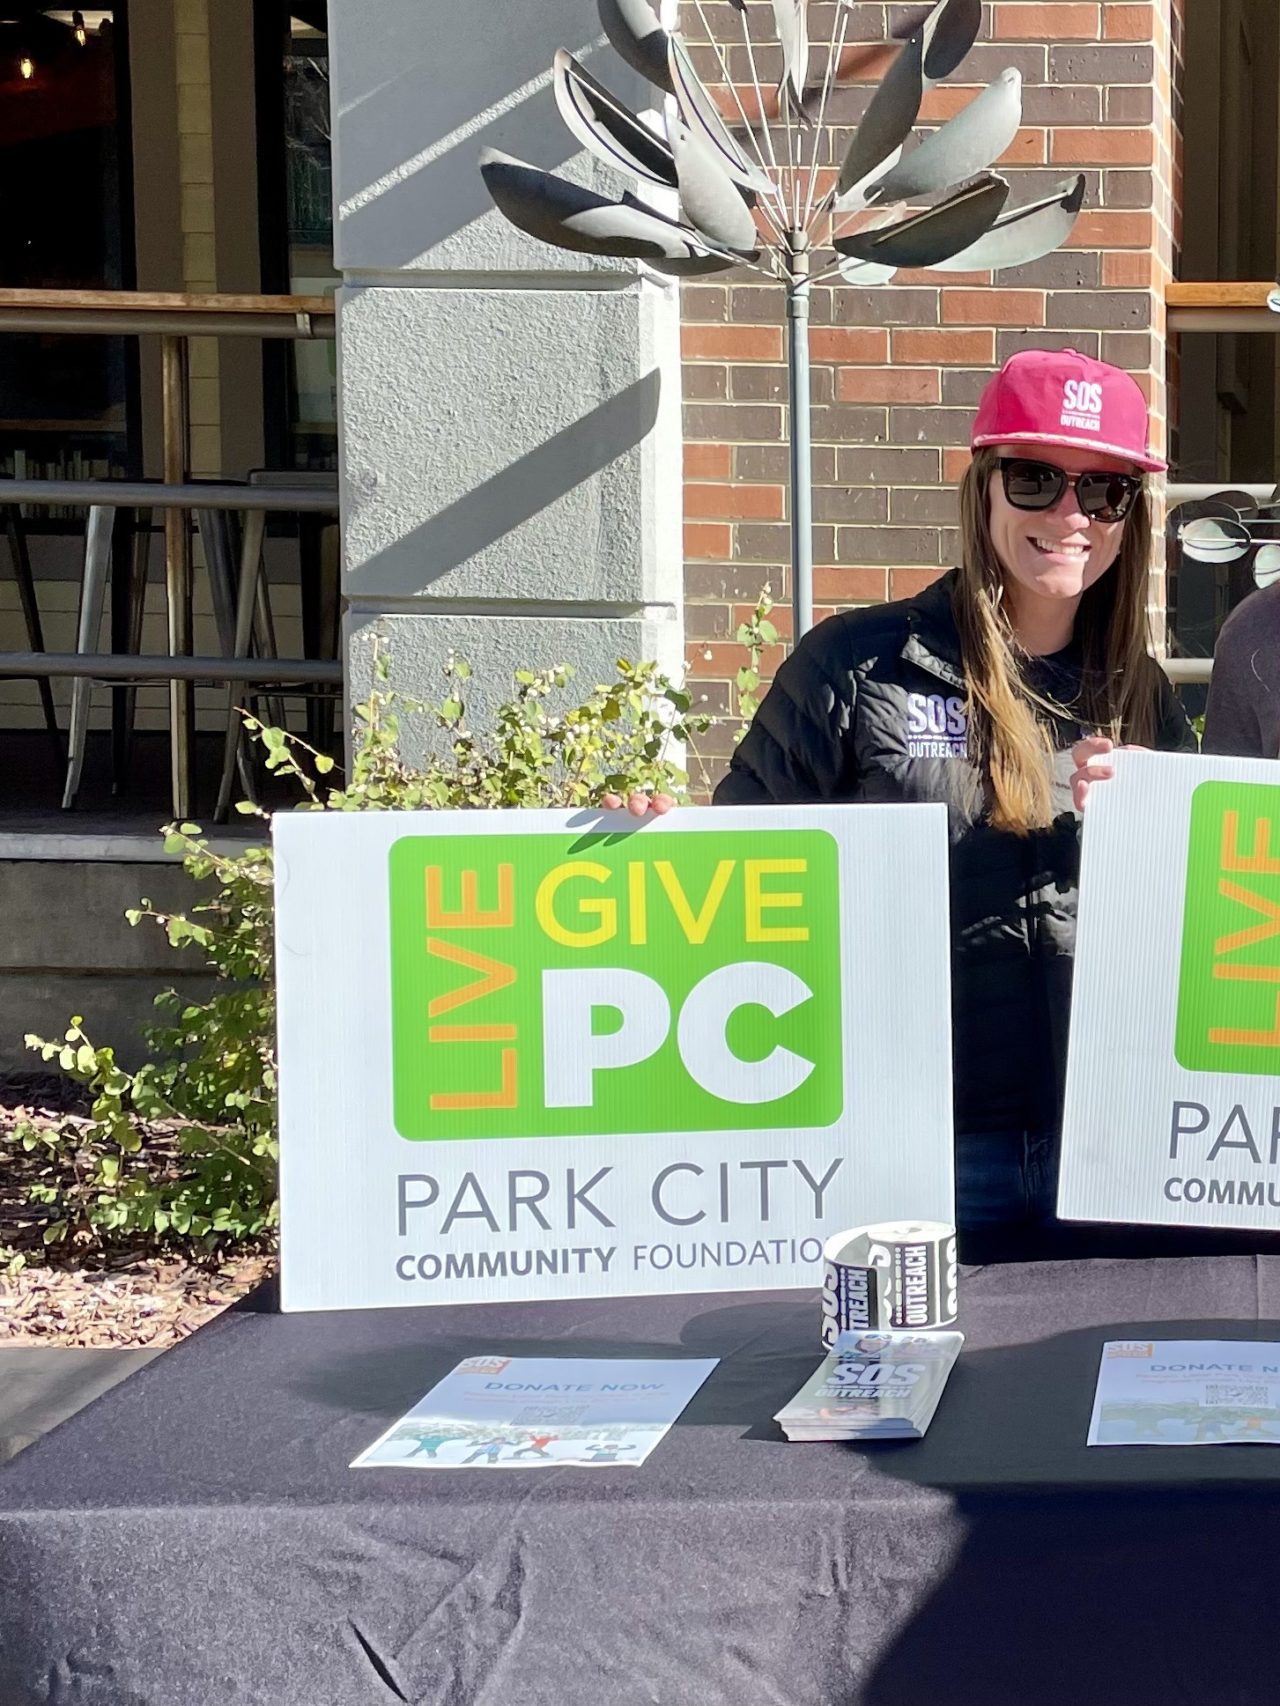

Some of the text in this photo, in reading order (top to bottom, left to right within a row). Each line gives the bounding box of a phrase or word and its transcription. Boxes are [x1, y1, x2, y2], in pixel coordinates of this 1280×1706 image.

[1063, 379, 1102, 414] SOS
[907, 693, 966, 735] SOS
[908, 741, 967, 758] OUTREACH
[535, 858, 810, 947] GIVE
[425, 863, 518, 1111] LIVE
[541, 961, 816, 1108] PC
[397, 1158, 845, 1236] PARK CITY
[396, 1238, 824, 1280] COMMUNITY FOUNDATIO
[904, 1245, 928, 1325] OUTREACH
[485, 1382, 665, 1392] DONATE NOW
[826, 1363, 926, 1386] SOS
[1151, 1363, 1251, 1373] DONATE
